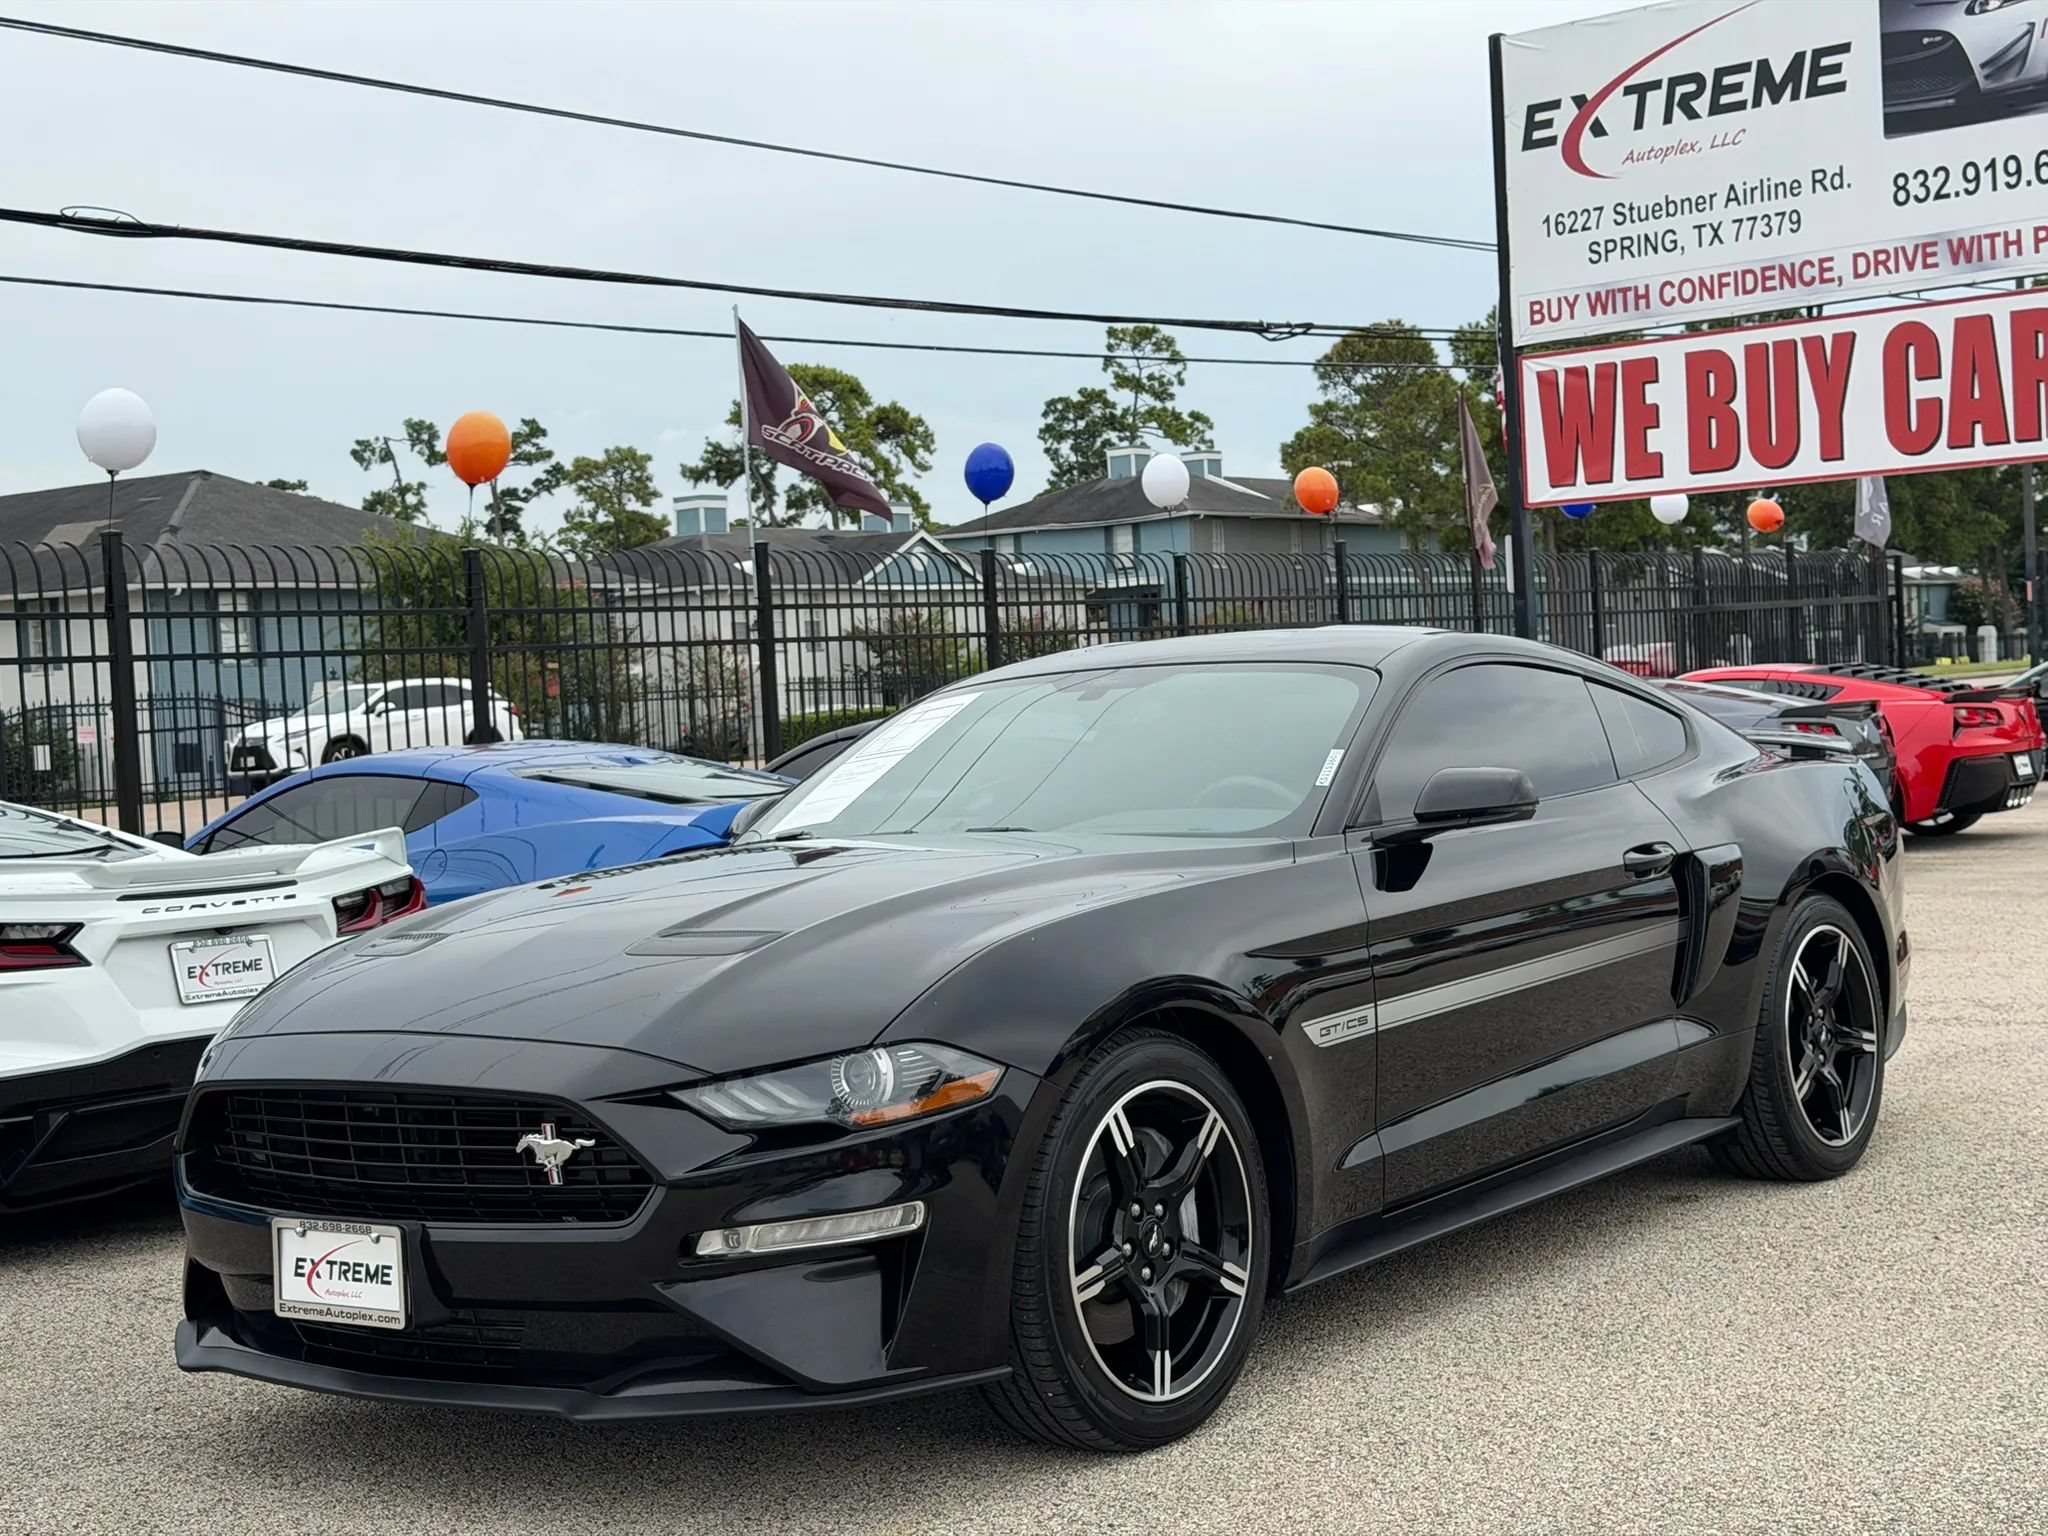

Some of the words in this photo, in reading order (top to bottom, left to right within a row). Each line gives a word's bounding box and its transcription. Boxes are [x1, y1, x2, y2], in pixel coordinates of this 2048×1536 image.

[1521, 41, 1852, 152] EXTREME
[1622, 138, 1701, 165] Autoplex,
[1710, 129, 1747, 149] LLC
[1542, 206, 1604, 238] 16227
[1613, 191, 1718, 227] Stuebner
[1724, 177, 1801, 208] Airline
[1811, 165, 1852, 194] Rd.
[1588, 229, 1685, 264] SPRING,
[1693, 220, 1724, 248] TX
[1732, 208, 1801, 242] 77379
[1529, 294, 1580, 326] BUY
[1586, 284, 1651, 317] WITH
[1659, 256, 1843, 307] CONFIDENCE,
[1852, 240, 1939, 279] DRIVE
[1947, 228, 2023, 266] WITH
[1536, 356, 1664, 488] WE
[1685, 331, 1856, 474] BUY
[142, 894, 297, 914] CORVETTE
[187, 958, 263, 979] EXTREME
[184, 986, 264, 1000] ExtremeAutoplex
[1319, 1015, 1368, 1038] GT/CS
[294, 1257, 392, 1285] EXTREME
[279, 1303, 401, 1325] ExtremeAutoplex.com
